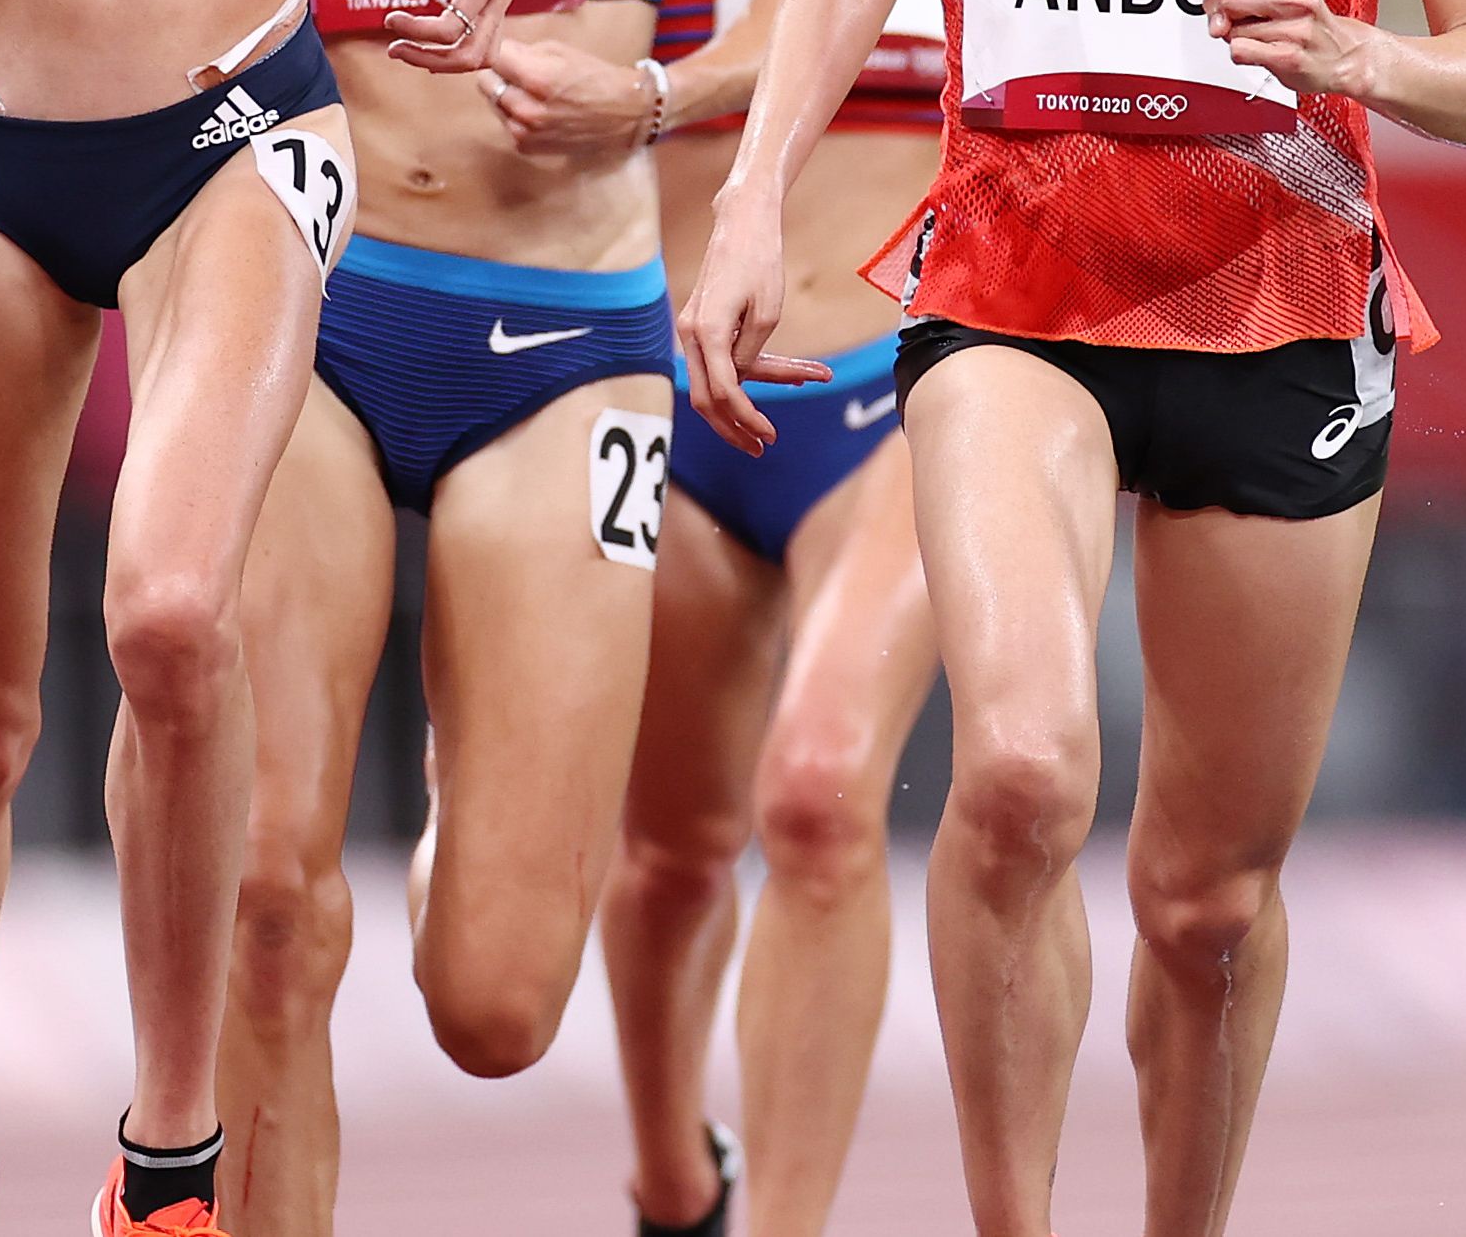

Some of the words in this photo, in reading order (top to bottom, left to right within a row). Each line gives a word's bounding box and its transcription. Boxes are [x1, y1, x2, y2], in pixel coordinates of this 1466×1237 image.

[1036, 94, 1089, 112] TOKYO
[1092, 96, 1131, 114] 2020
[192, 108, 280, 150] adidas
[599, 427, 669, 554] 23
